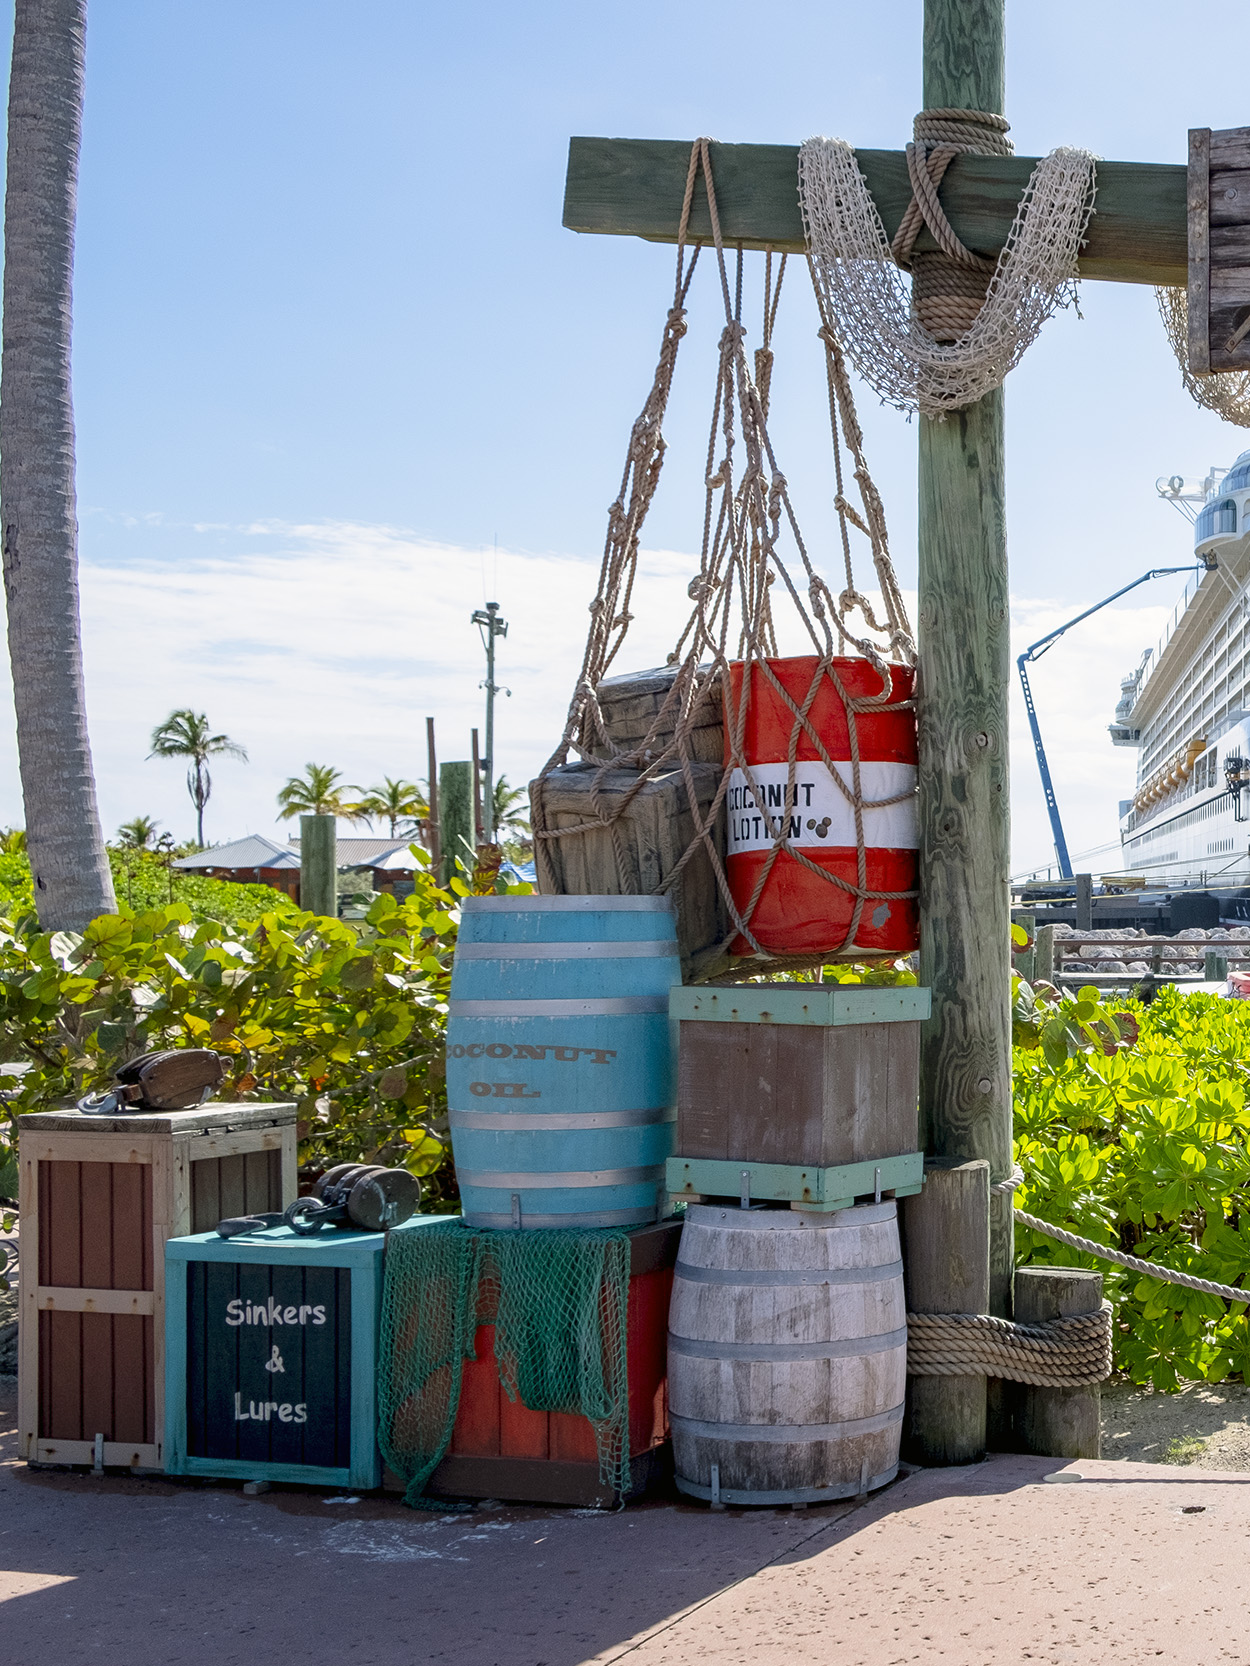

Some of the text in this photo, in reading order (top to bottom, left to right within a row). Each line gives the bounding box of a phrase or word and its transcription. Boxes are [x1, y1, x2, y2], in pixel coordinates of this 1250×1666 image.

[469, 1081, 541, 1098] OIL
[225, 1296, 326, 1326] Sinkers
[265, 1345, 285, 1373] &
[234, 1391, 307, 1423] Lures
